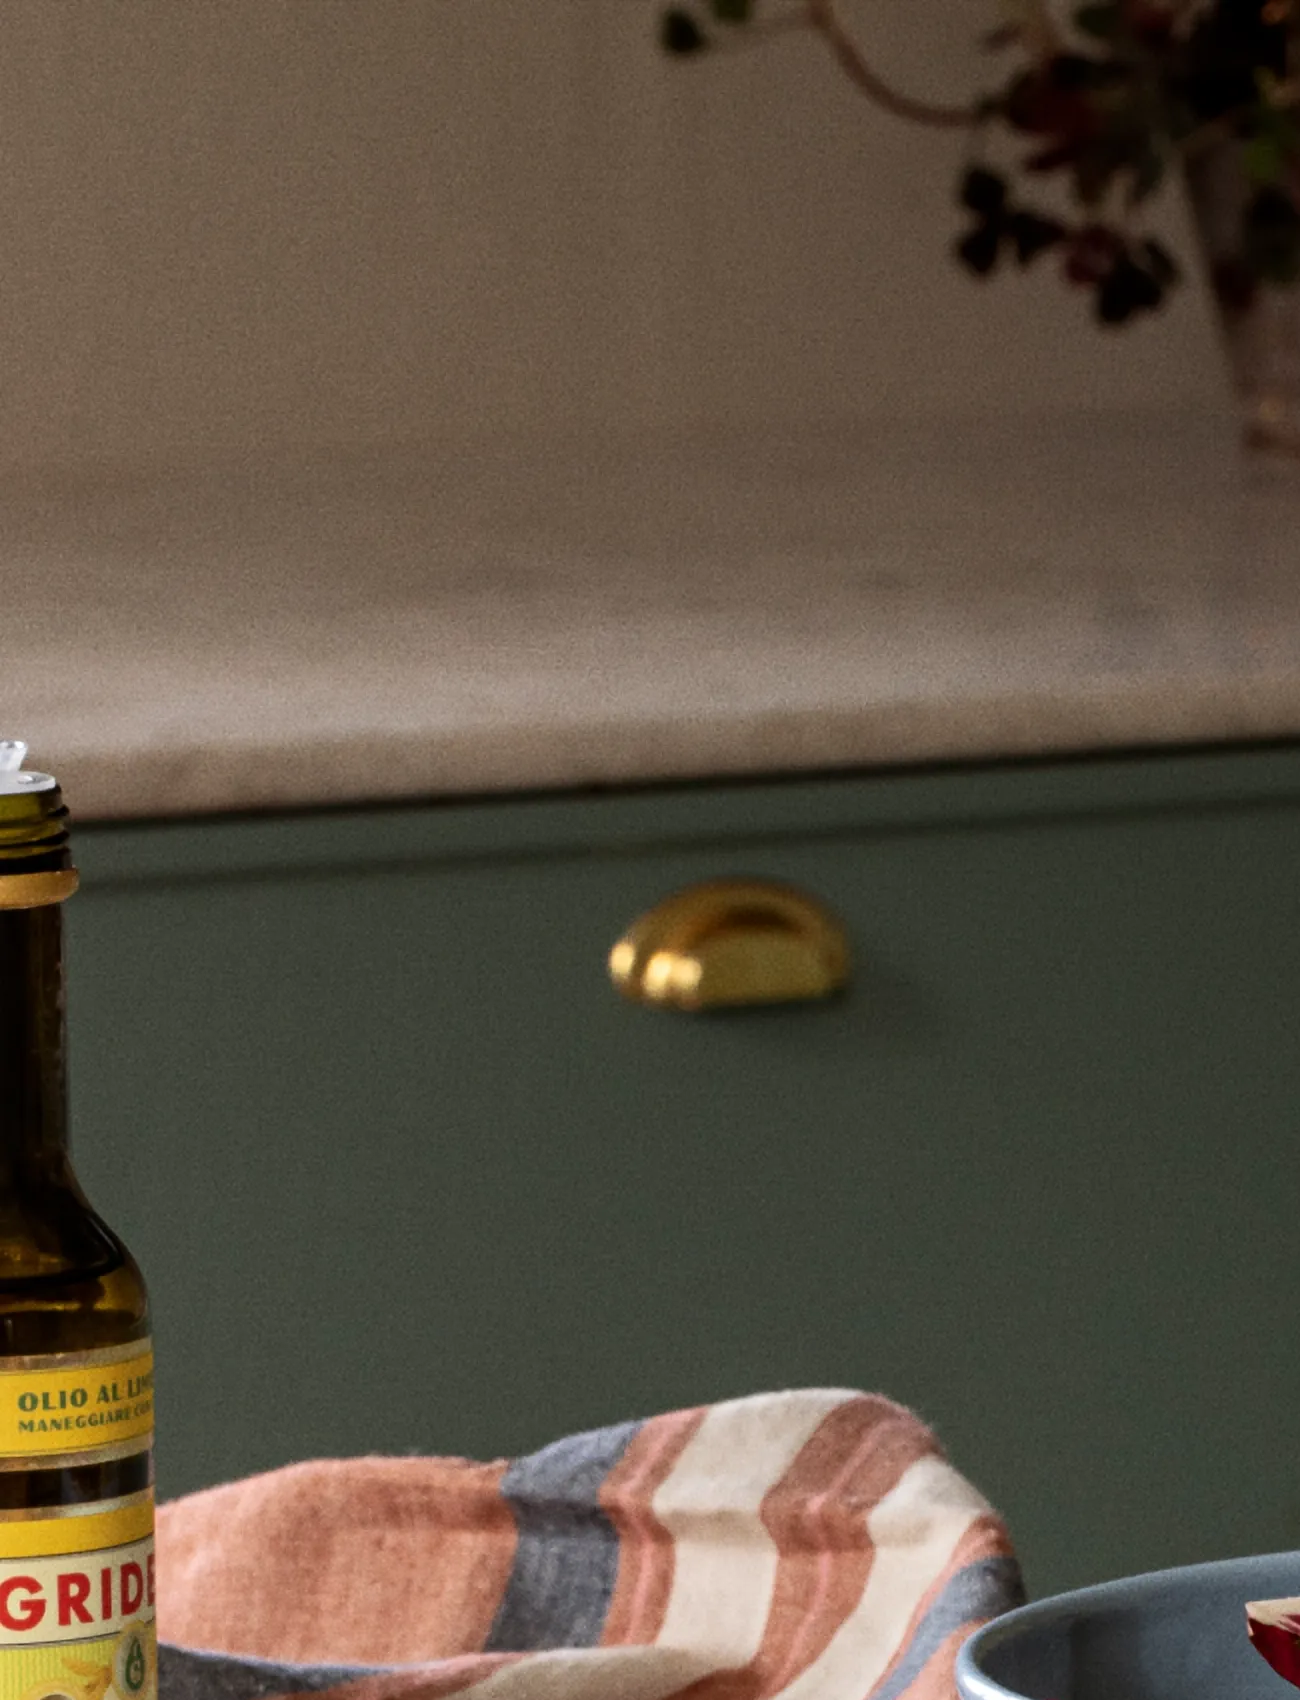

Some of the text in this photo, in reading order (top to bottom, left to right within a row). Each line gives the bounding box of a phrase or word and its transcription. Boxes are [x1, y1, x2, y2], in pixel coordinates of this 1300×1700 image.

[17, 1388, 89, 1412] OLIO
[96, 1382, 121, 1404] AL
[17, 1407, 130, 1433] MANEGGIARE
